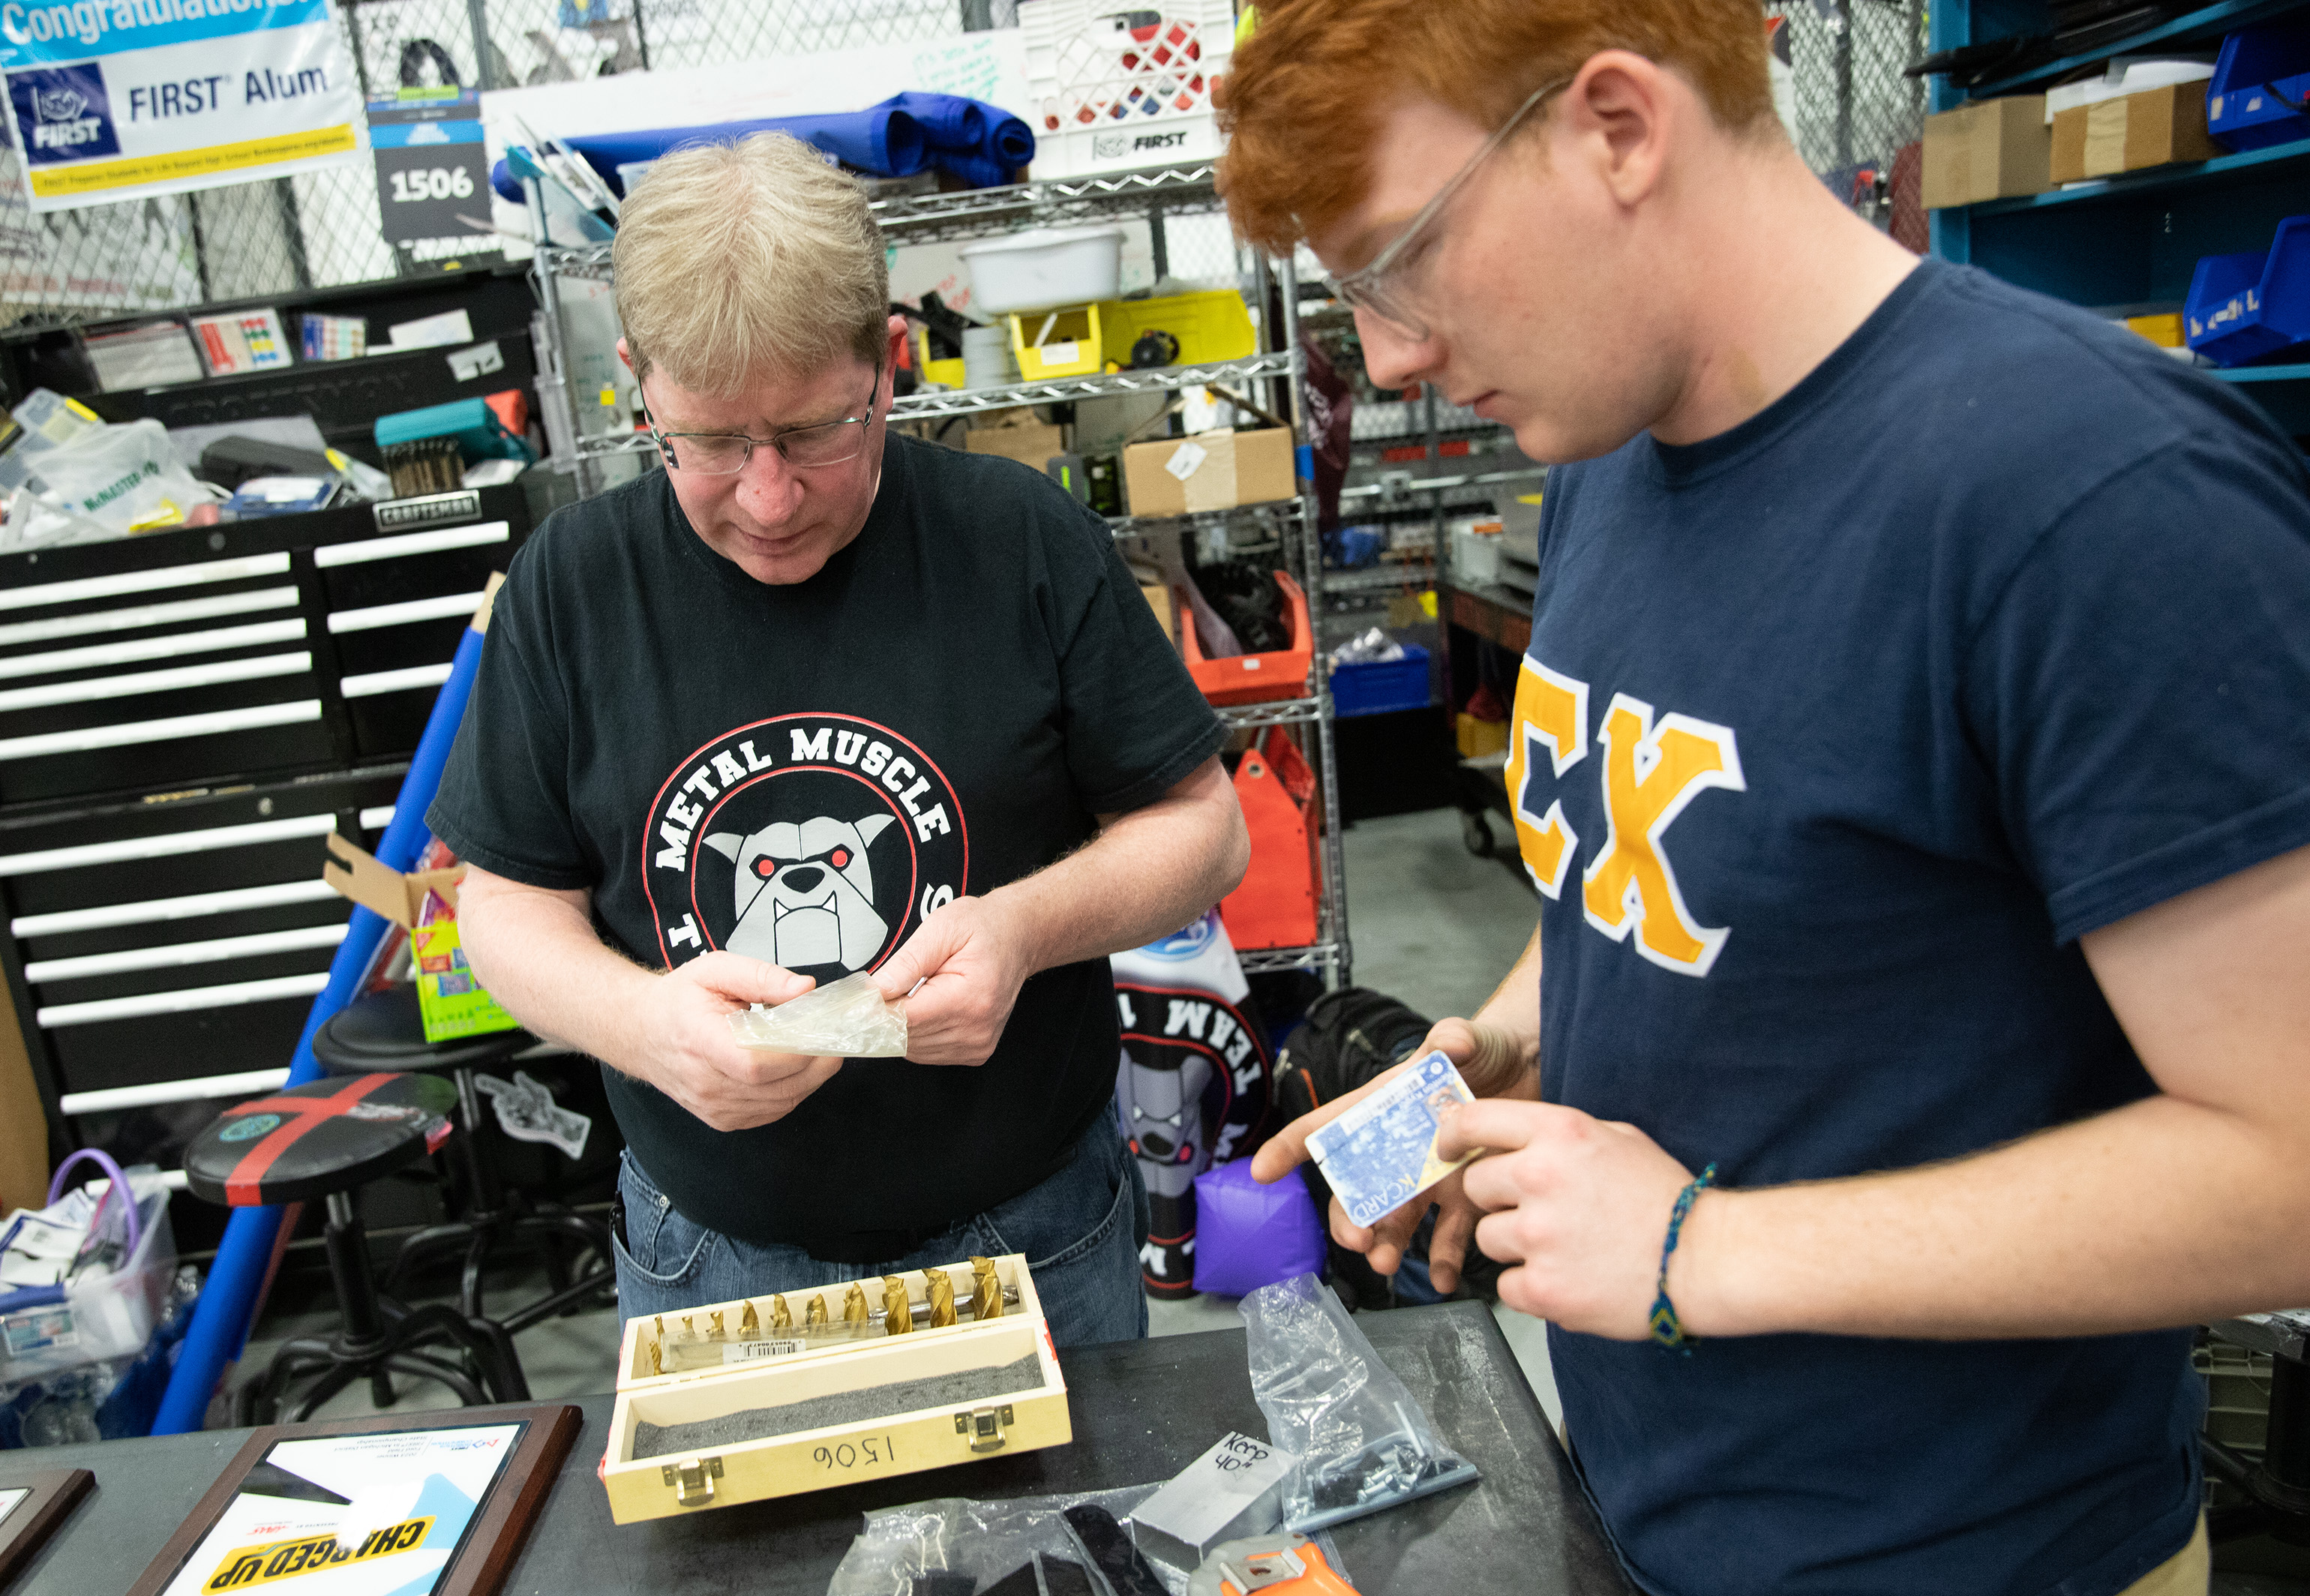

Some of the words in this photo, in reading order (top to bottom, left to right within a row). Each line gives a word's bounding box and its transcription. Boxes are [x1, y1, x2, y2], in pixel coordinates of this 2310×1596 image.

[130, 76, 223, 122] FIRST
[245, 68, 328, 105] Alum
[33, 118, 101, 148] FIRST
[1135, 131, 1187, 151] FIRST
[389, 166, 474, 202] 1506
[656, 740, 772, 872] METAL
[790, 728, 951, 843] MUSCLE
[1163, 999, 1262, 1096] TEAM
[1352, 1173, 1416, 1220] KCARD
[814, 1436, 894, 1468] 1506
[1223, 1432, 1268, 1461] Keep
[263, 1521, 426, 1577] CHARGED
[210, 1556, 263, 1589] UP
